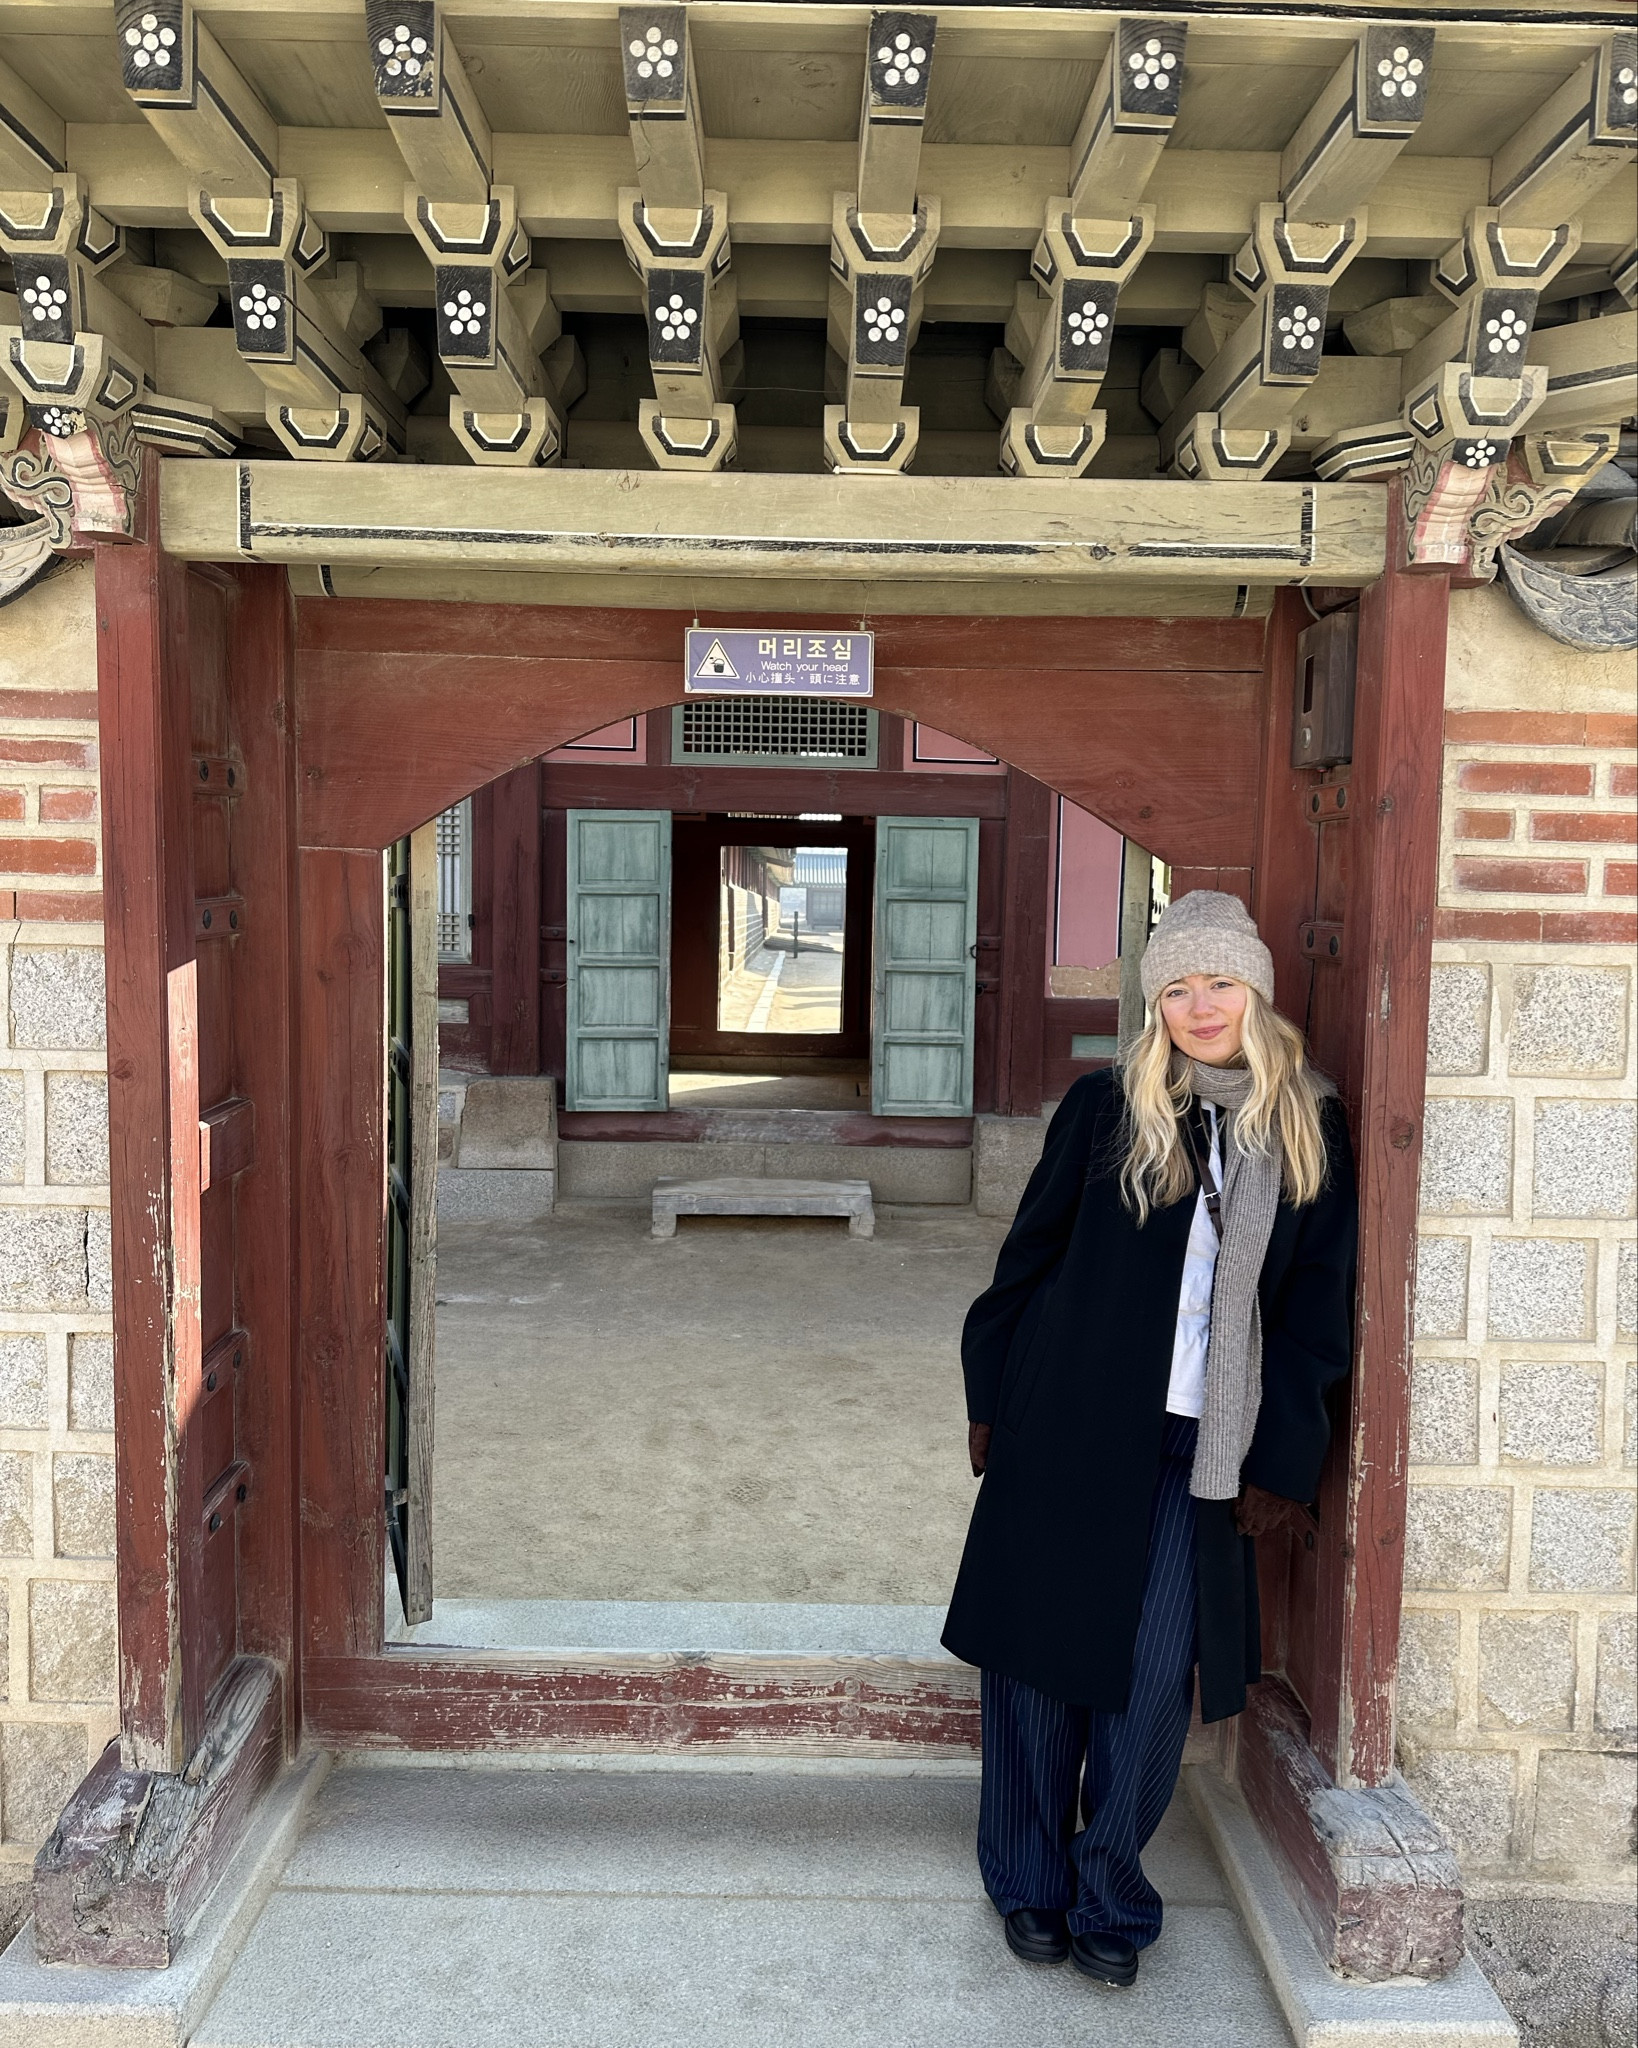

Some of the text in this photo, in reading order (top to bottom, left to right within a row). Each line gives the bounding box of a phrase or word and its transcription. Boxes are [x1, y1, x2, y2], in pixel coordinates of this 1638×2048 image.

[758, 637, 852, 660] 머리조심
[761, 661, 848, 673] Watch your head
